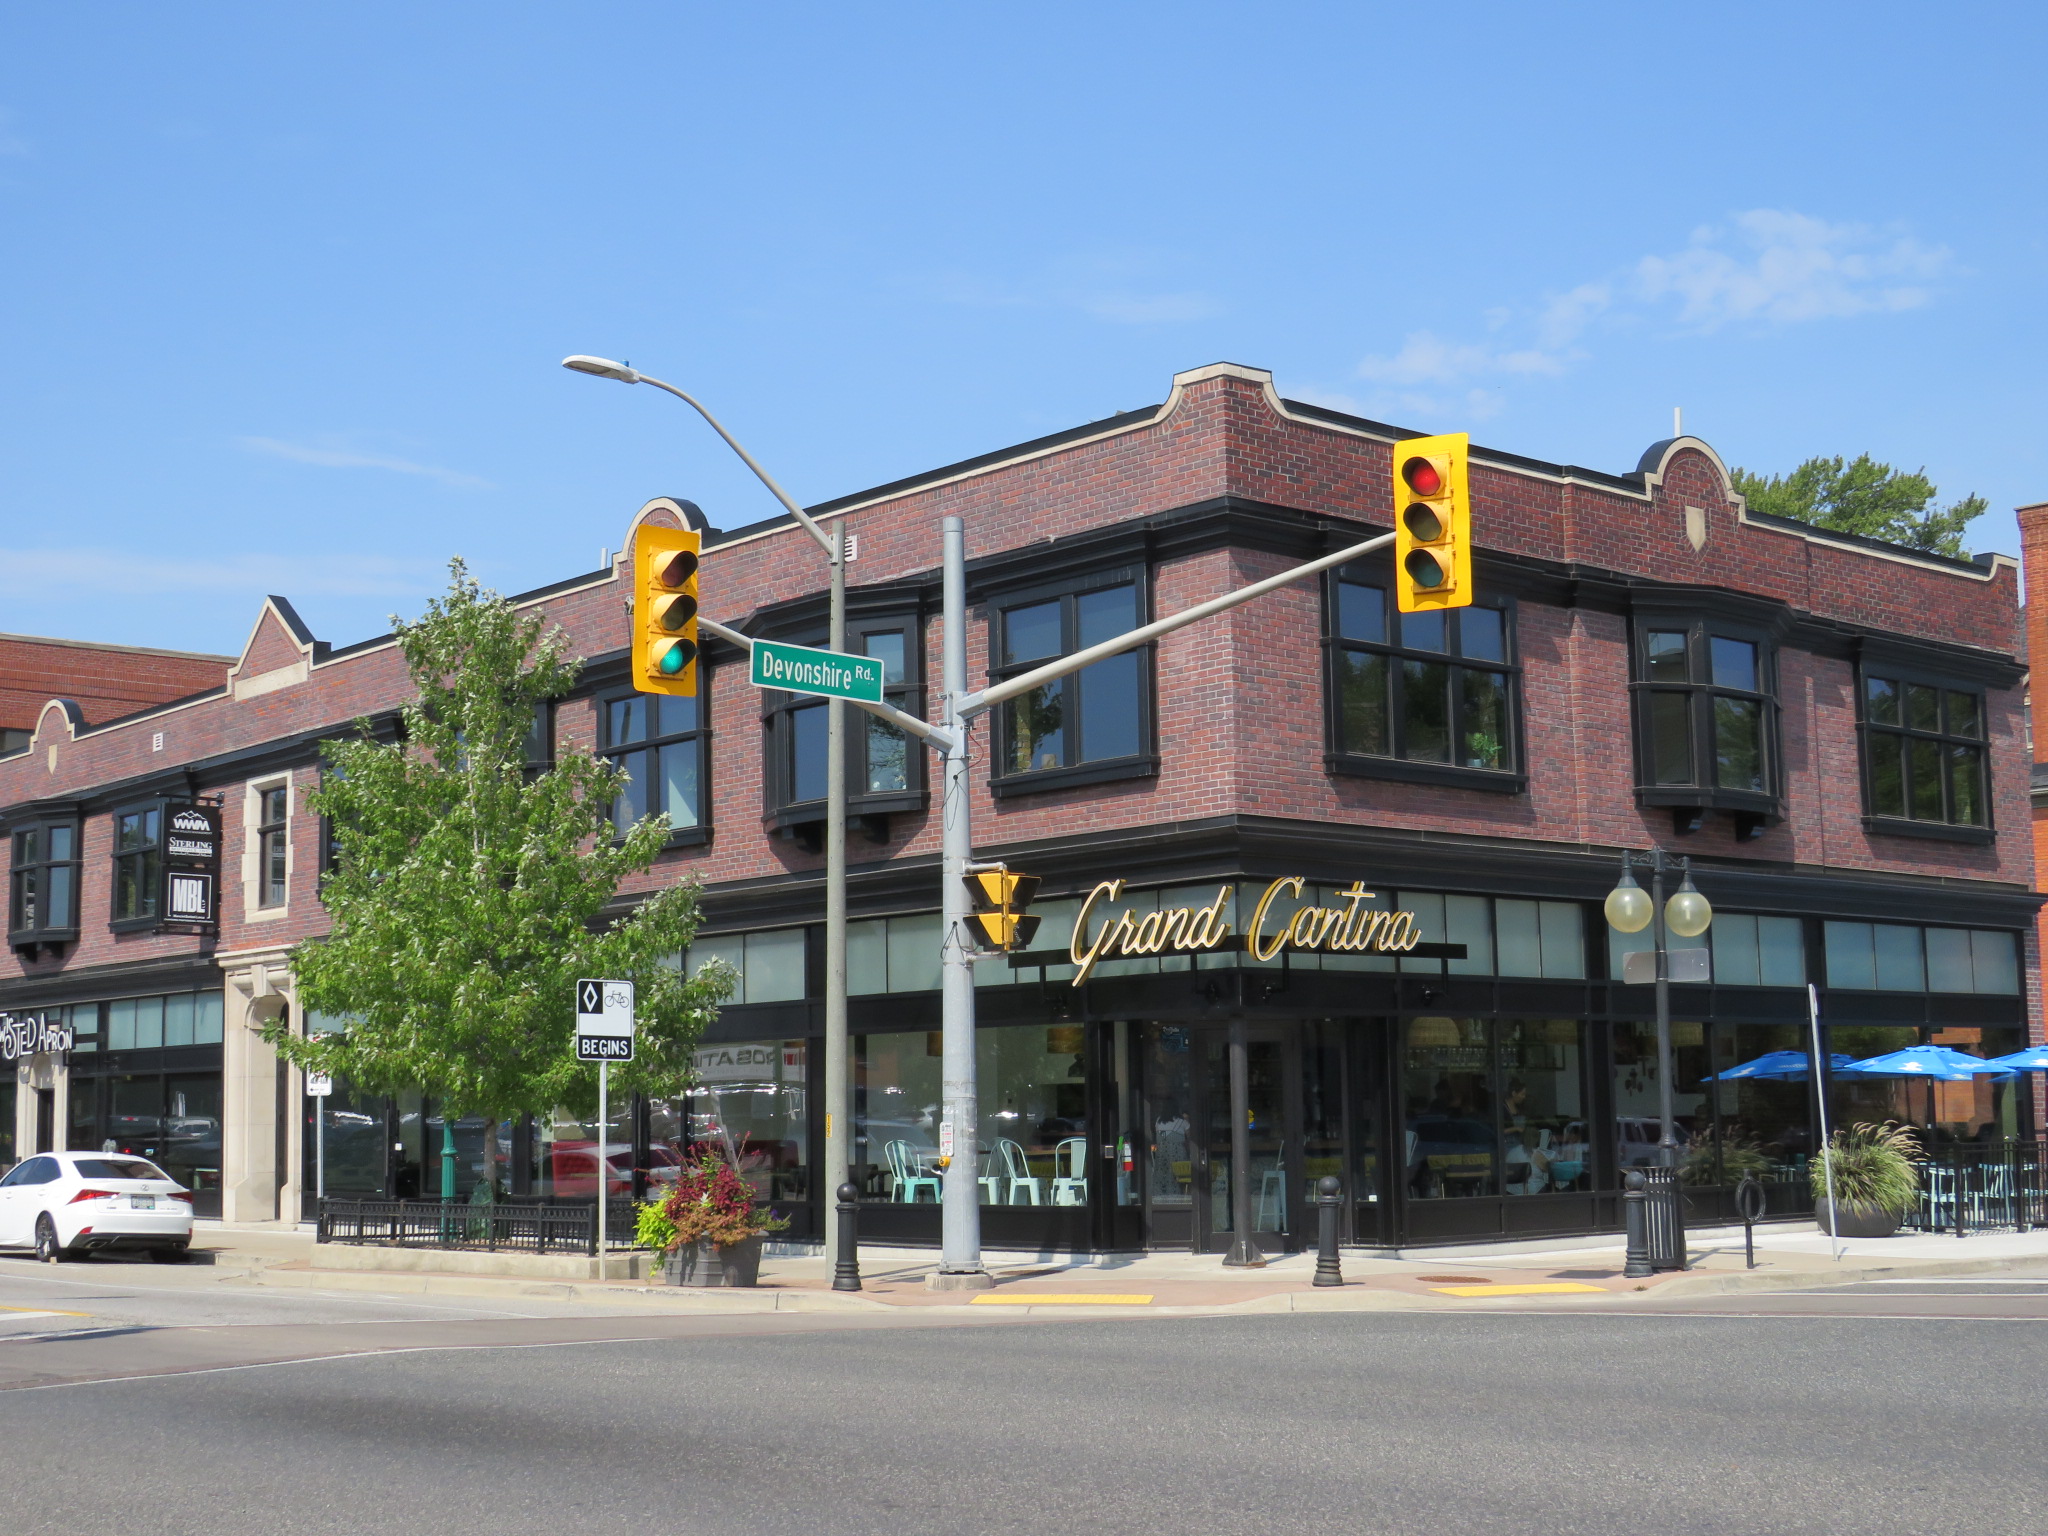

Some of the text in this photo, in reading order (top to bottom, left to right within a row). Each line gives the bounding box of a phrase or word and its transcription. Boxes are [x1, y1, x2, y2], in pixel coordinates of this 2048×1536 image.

[763, 651, 875, 690] Devonshire Rd.
[173, 878, 205, 913] MBL
[1071, 876, 1422, 987] Grand Cantina
[582, 1039, 628, 1056] BEGINS
